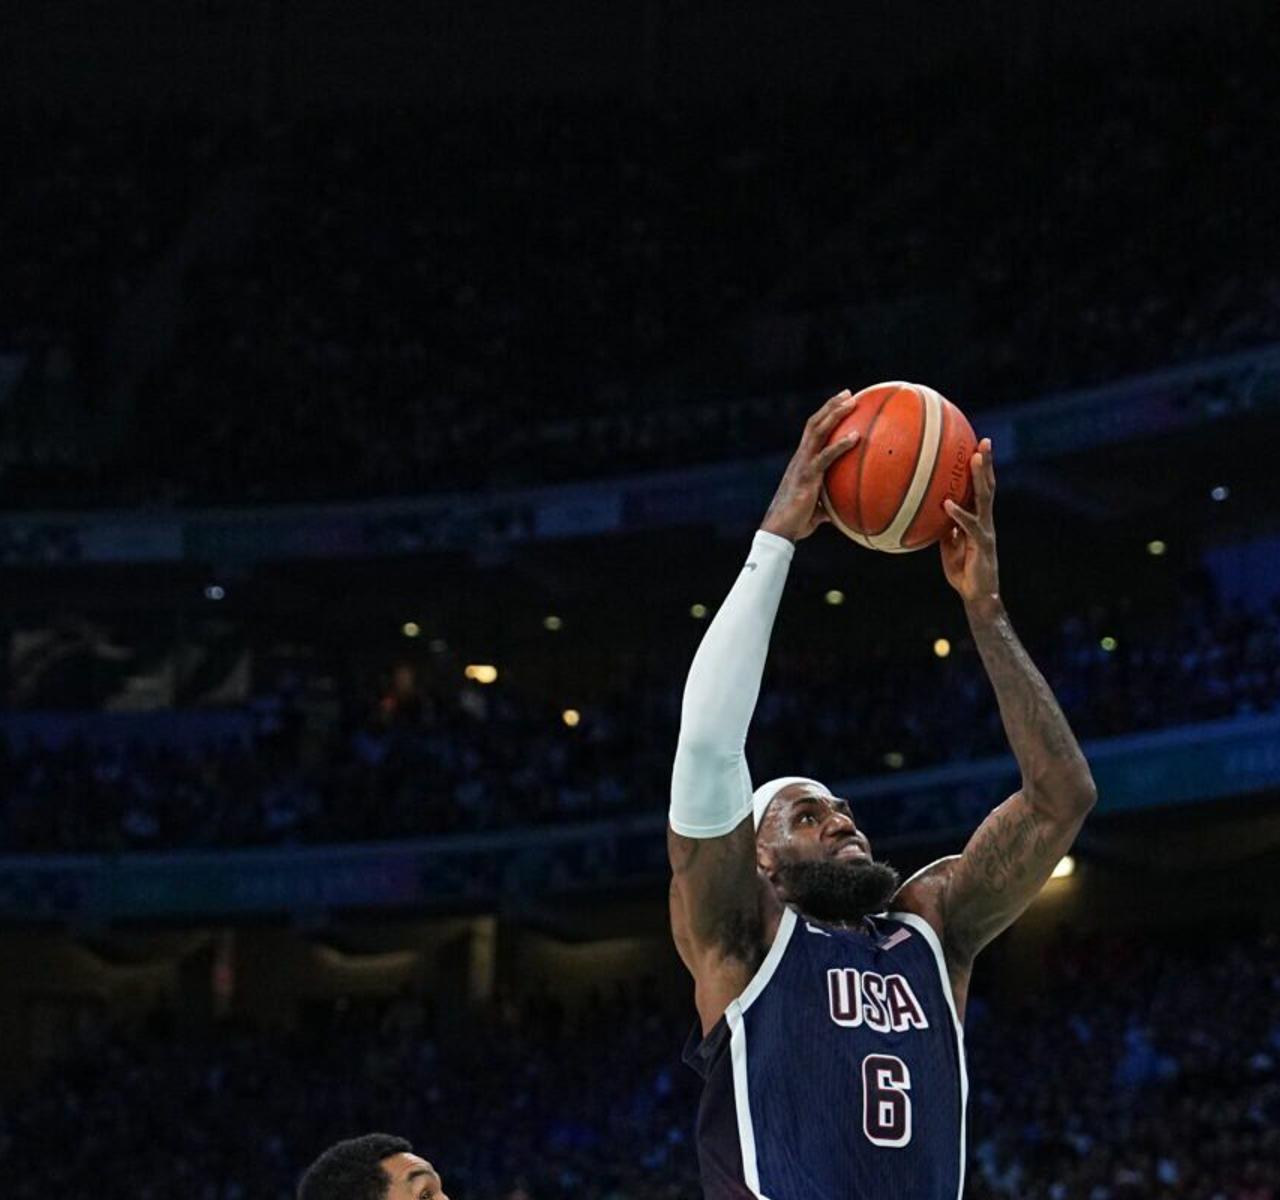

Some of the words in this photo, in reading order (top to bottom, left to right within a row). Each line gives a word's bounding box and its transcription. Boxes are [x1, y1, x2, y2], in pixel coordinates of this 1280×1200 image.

[947, 439, 967, 500] olten
[827, 967, 929, 1033] USA
[862, 1053, 912, 1148] 6
